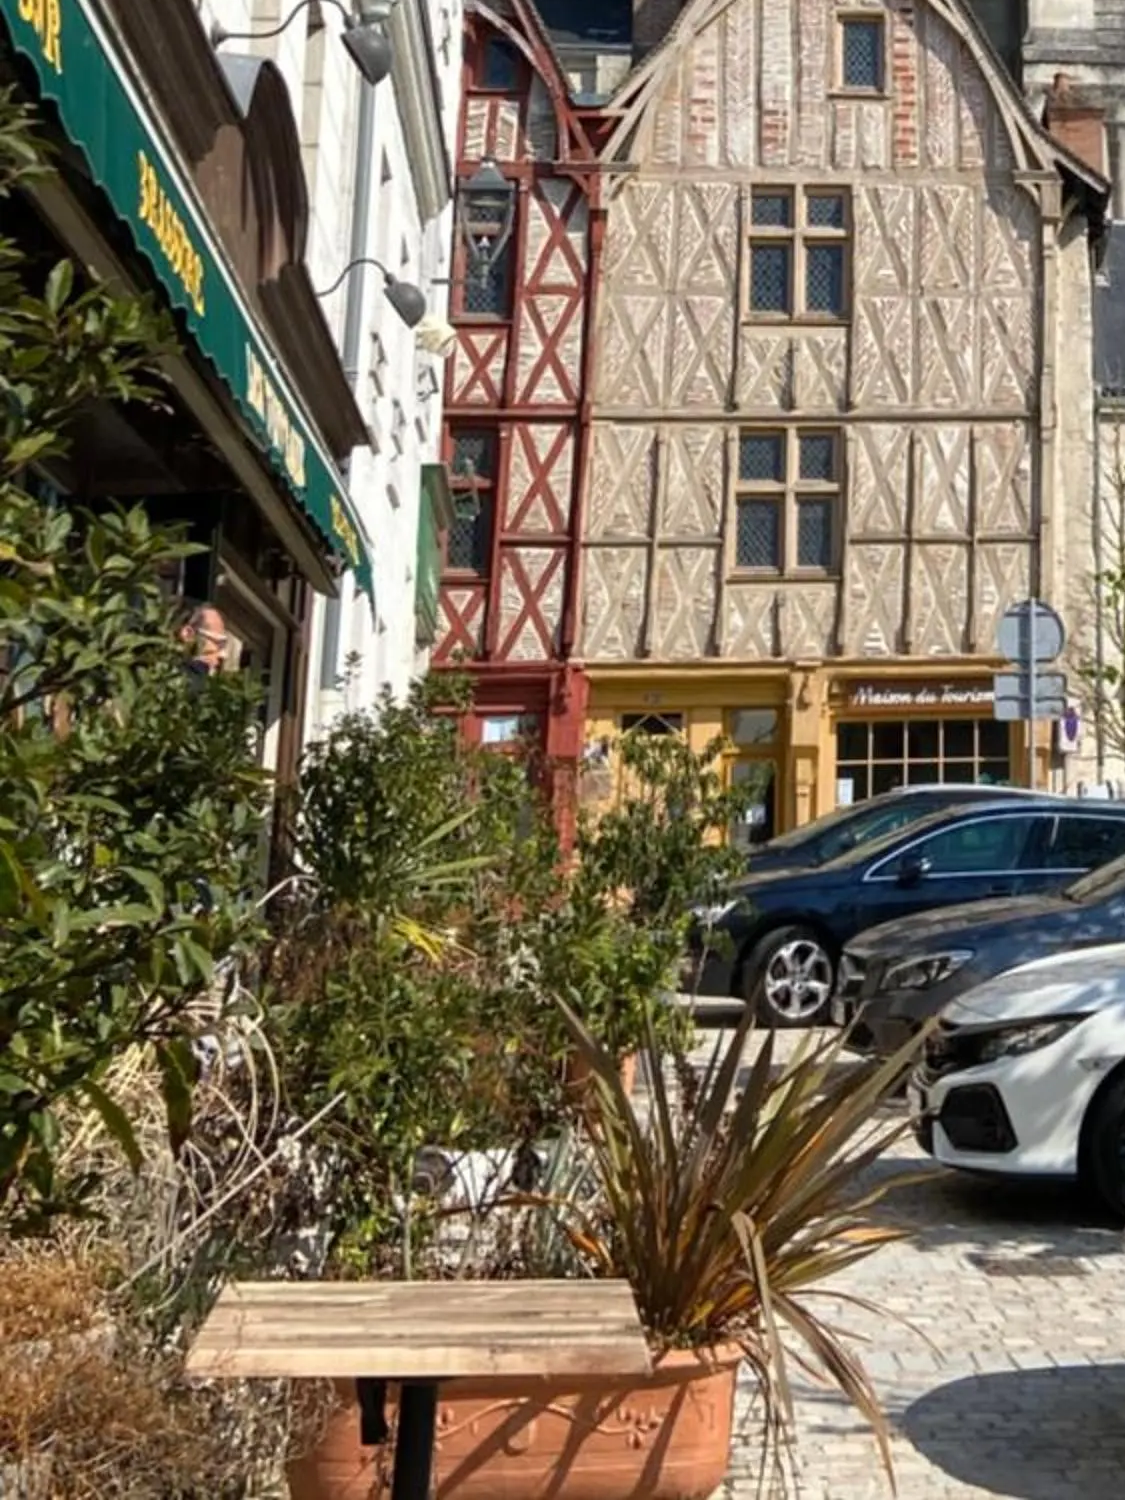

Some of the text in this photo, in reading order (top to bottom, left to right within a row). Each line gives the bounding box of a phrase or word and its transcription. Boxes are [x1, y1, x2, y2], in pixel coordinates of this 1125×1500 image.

[851, 684, 995, 706] Maison du Tourism
